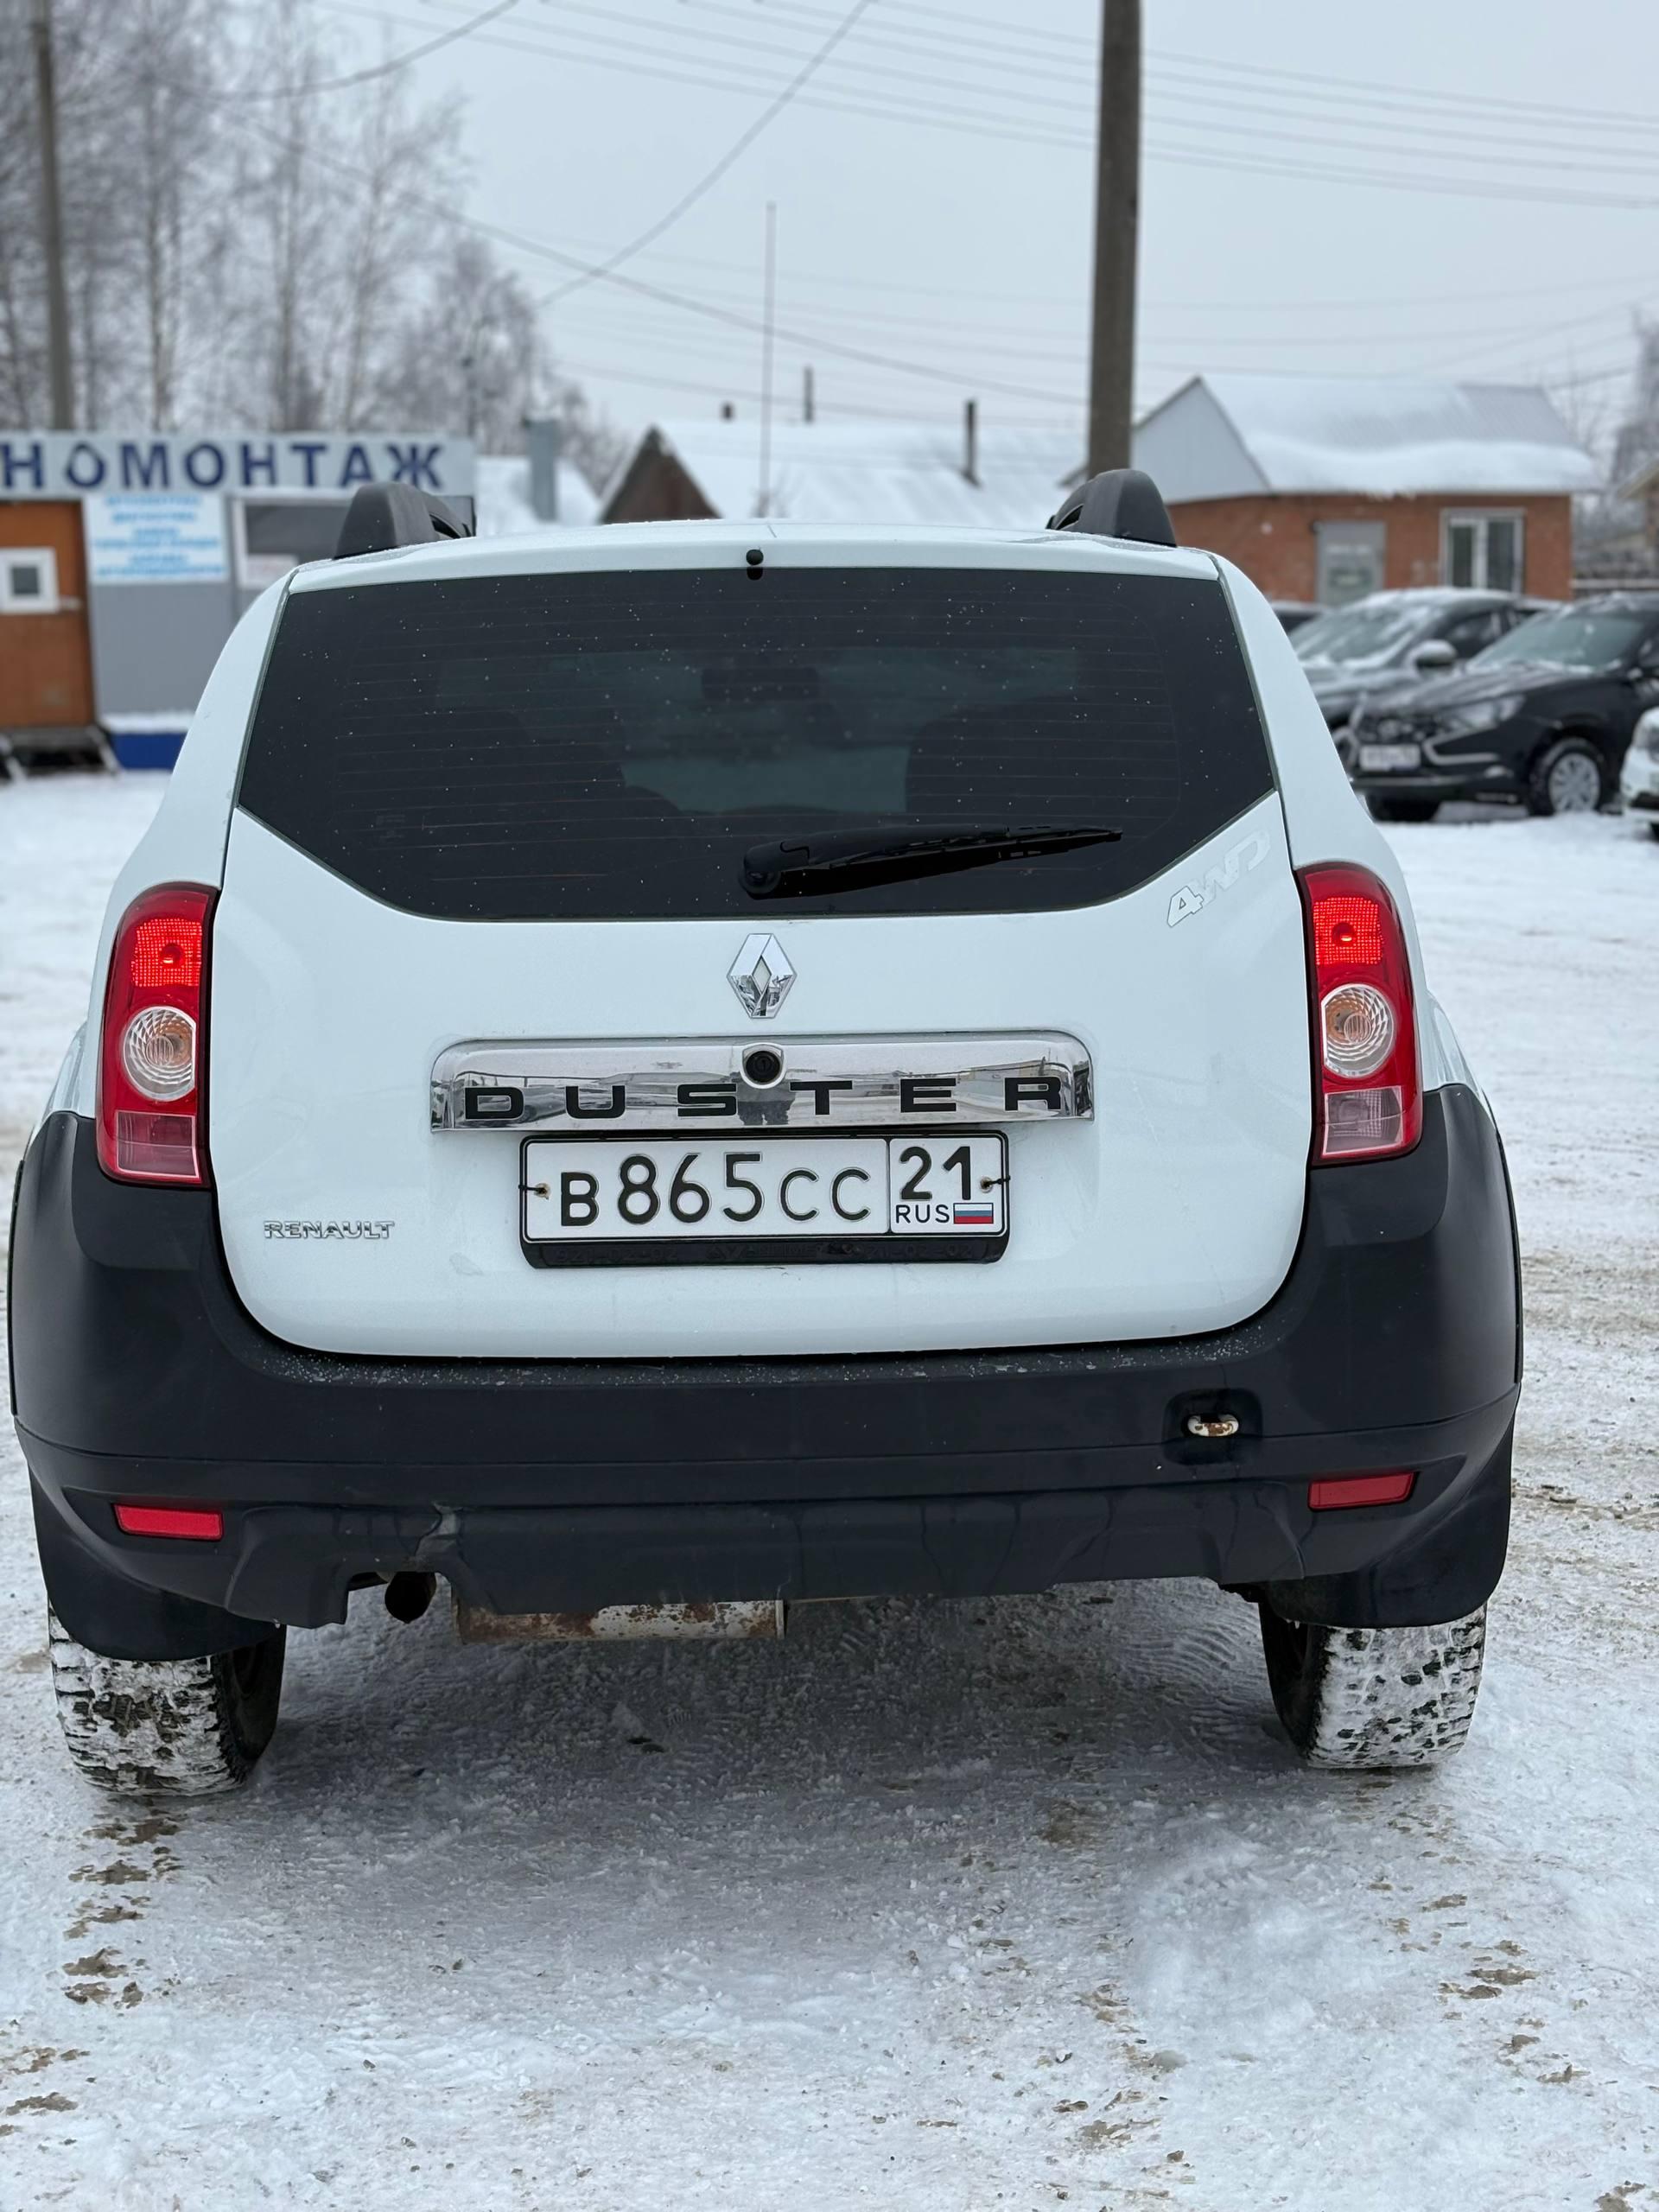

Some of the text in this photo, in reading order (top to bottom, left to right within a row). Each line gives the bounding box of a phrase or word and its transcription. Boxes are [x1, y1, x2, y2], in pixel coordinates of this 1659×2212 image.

[0, 442, 442, 489] НОМОНТАЖ
[465, 1077, 1063, 1121] DUSTER
[559, 1151, 871, 1227] В865СС
[899, 1145, 972, 1201] 21
[264, 1220, 395, 1240] RENAULT
[895, 1205, 950, 1224] RUS
